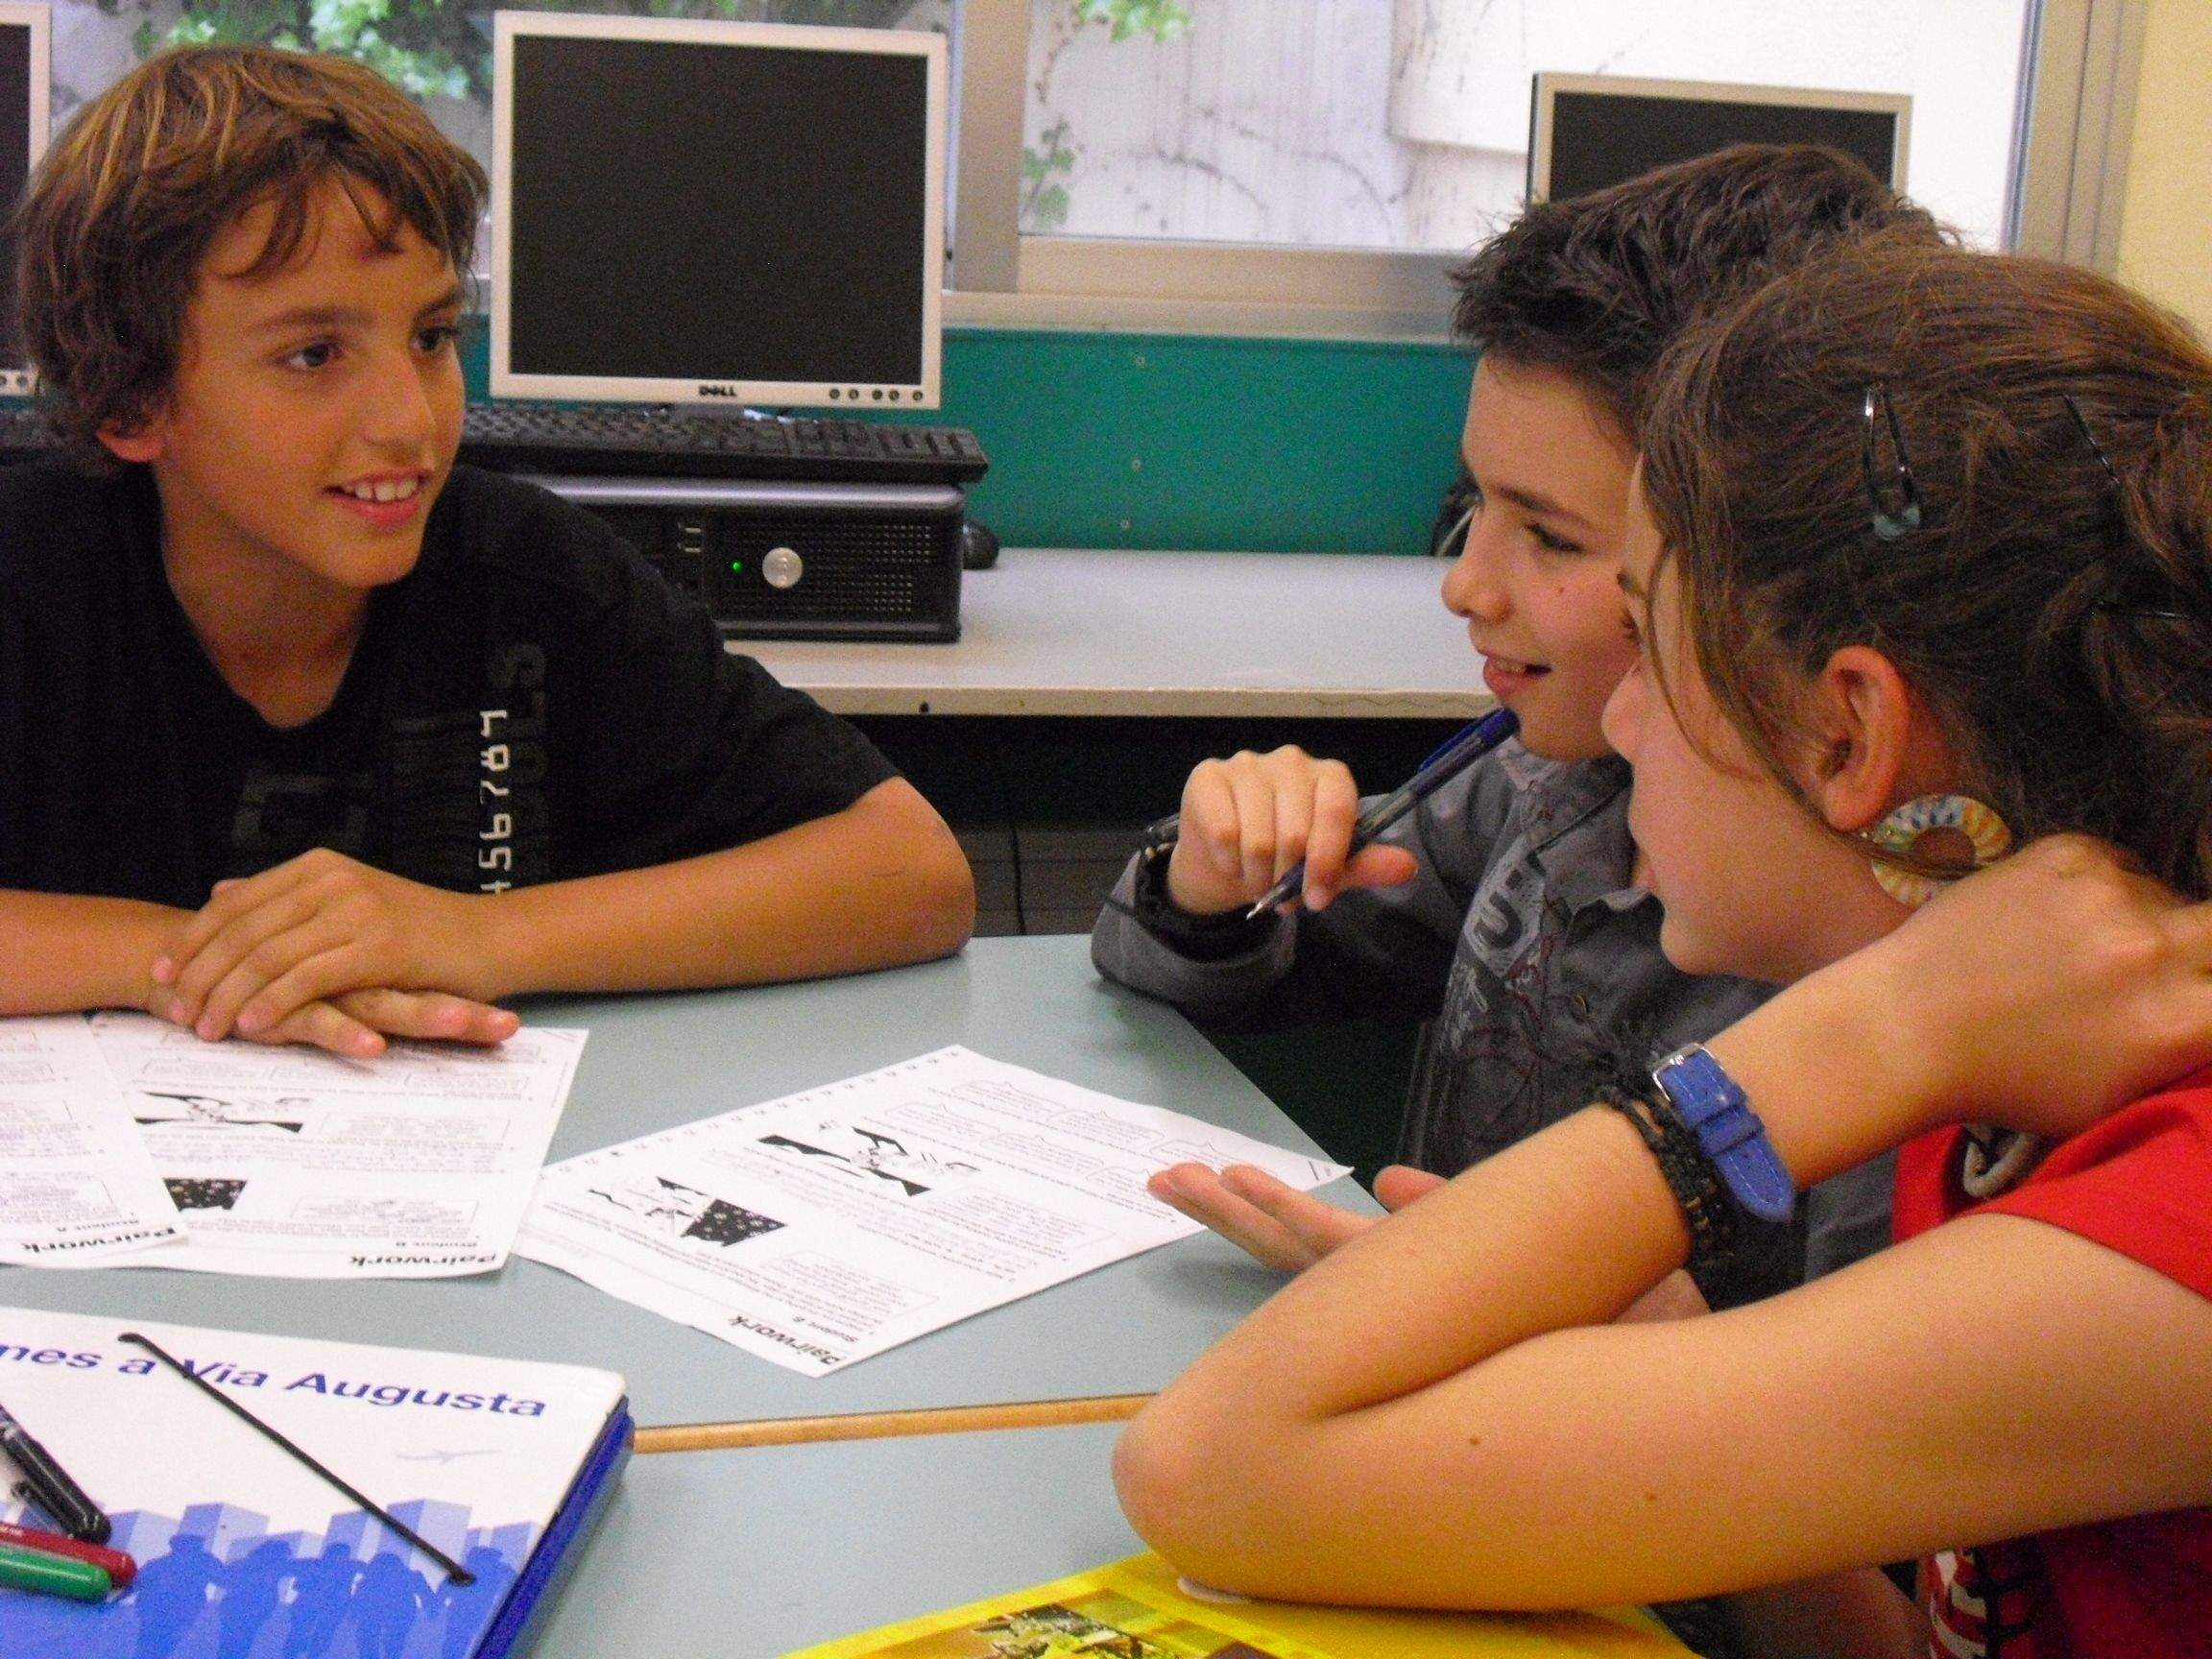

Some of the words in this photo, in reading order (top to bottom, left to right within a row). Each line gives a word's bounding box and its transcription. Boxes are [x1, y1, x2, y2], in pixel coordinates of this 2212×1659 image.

[698, 384, 737, 397] DELL
[349, 1252, 497, 1267] Pairwork
[729, 1315, 841, 1365] Pairwork
[117, 1358, 156, 1375] a
[180, 1357, 269, 1390] Via
[284, 1371, 548, 1419] Augusta
